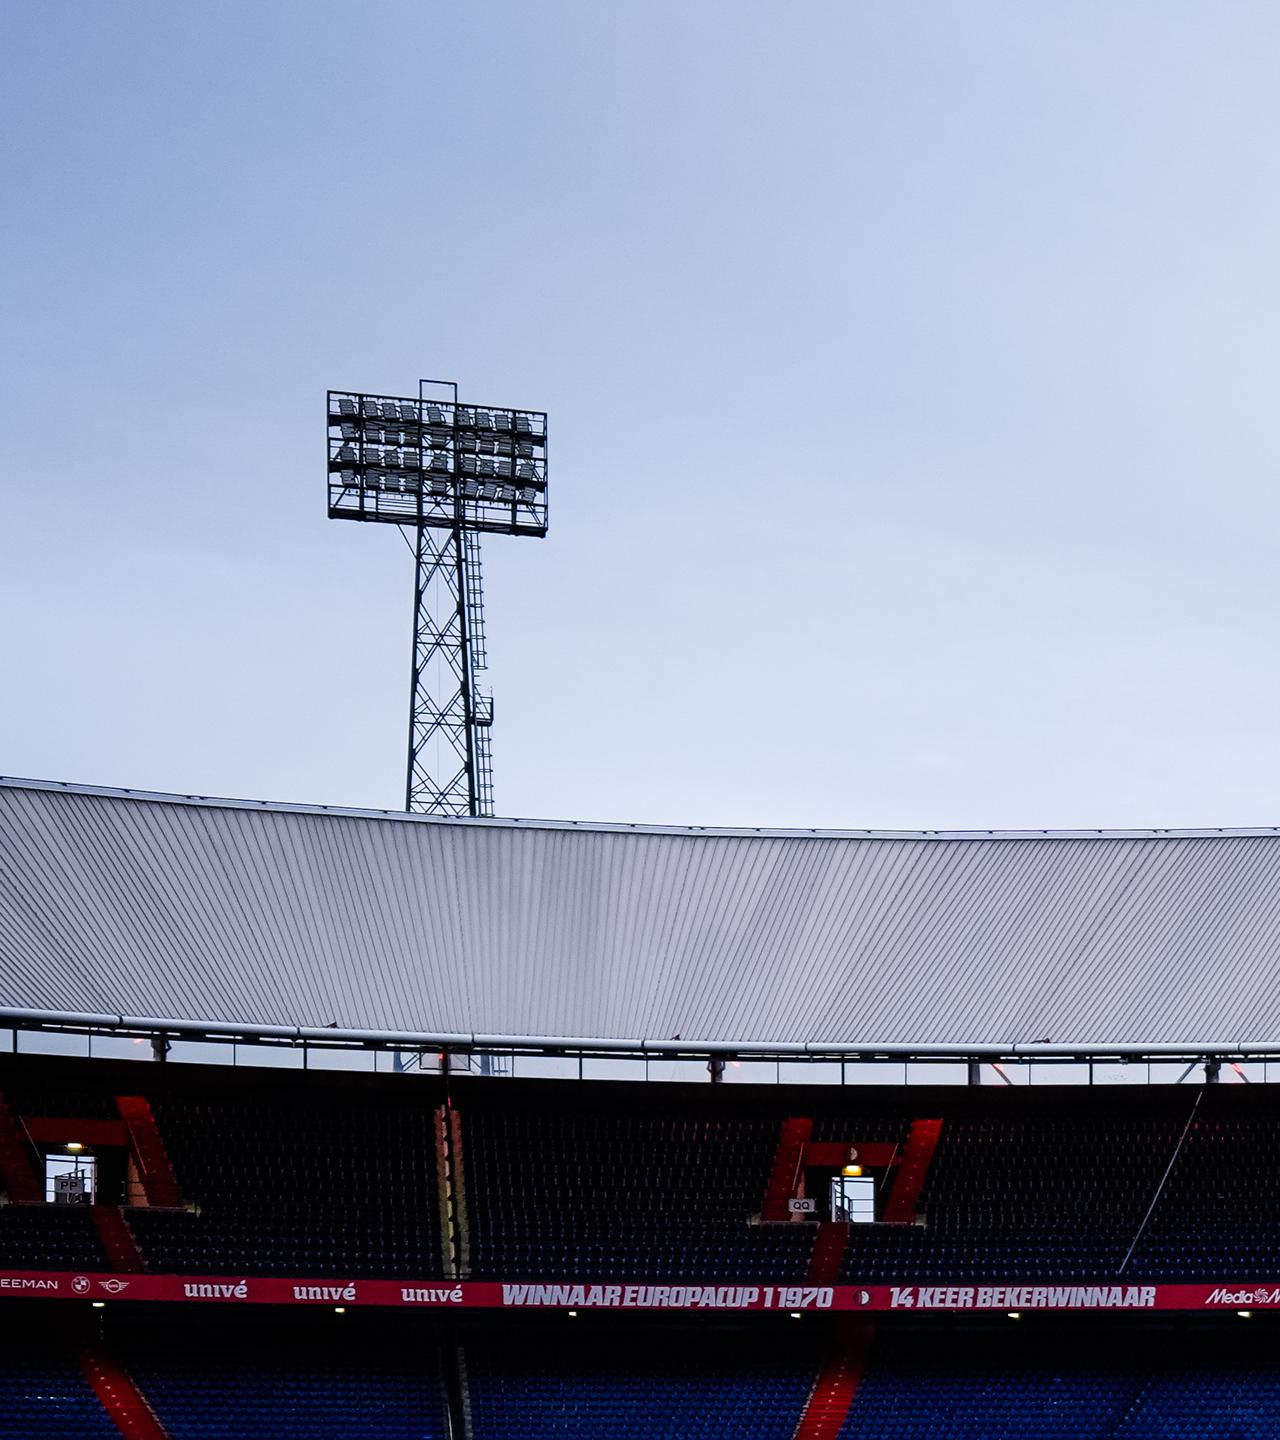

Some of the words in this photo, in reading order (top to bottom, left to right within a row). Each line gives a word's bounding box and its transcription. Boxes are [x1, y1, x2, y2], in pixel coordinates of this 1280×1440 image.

[61, 1181, 78, 1191] PP
[793, 1201, 810, 1210] QQ
[184, 1279, 248, 1300] univé
[293, 1279, 357, 1302] univé
[401, 1282, 464, 1304] univé
[501, 1284, 622, 1307] WINNAAR
[622, 1286, 759, 1308] EUROPACUP
[777, 1286, 834, 1309] 1970
[890, 1286, 915, 1308] 14
[916, 1286, 974, 1308] KEER
[975, 1285, 1156, 1308] BEKERWINNAAR
